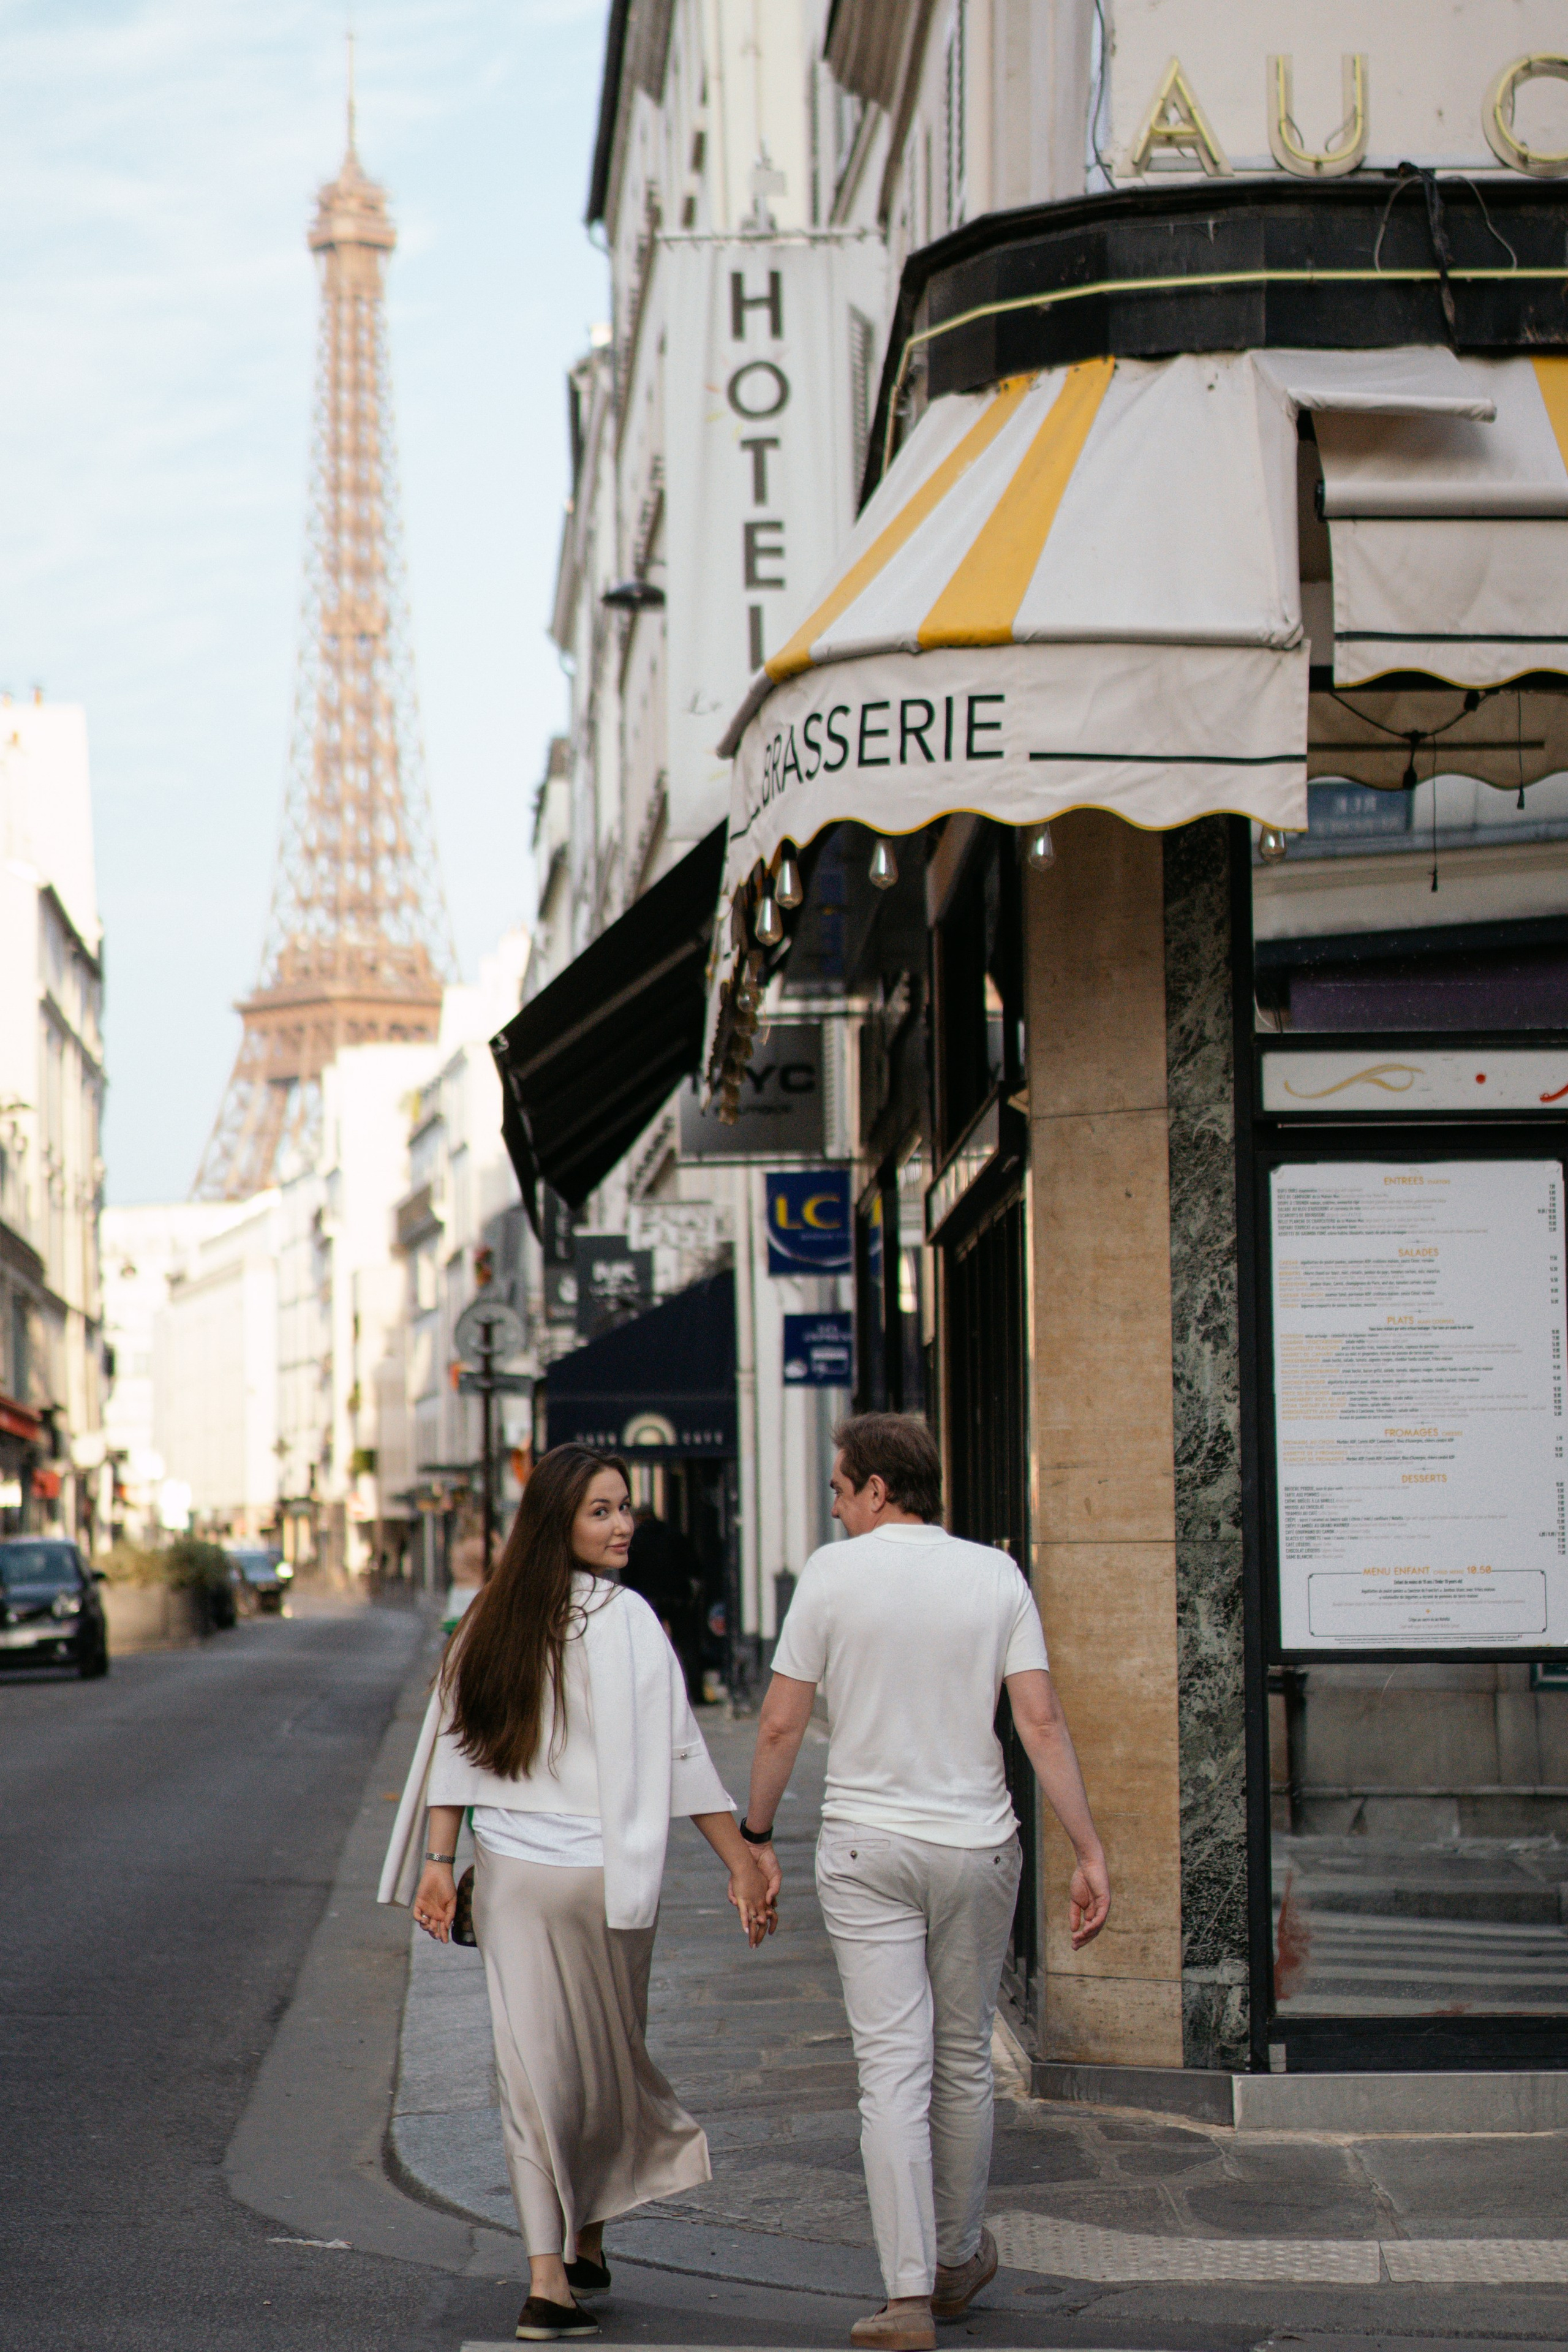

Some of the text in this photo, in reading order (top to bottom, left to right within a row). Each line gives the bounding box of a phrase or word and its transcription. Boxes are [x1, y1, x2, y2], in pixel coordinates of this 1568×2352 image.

[1115, 54, 1370, 179] AU
[760, 693, 1006, 807] BRASSERIE
[1384, 1177, 1424, 1185] ENTREES
[1398, 1248, 1439, 1257] SALADES
[1387, 1316, 1414, 1324] PLATS
[1385, 1428, 1438, 1437] FROMAGES
[1401, 1474, 1447, 1483] DESSERTS
[1363, 1567, 1391, 1576] MENU
[1393, 1566, 1430, 1575] ENFANT
[1467, 1565, 1492, 1574] 10.50
